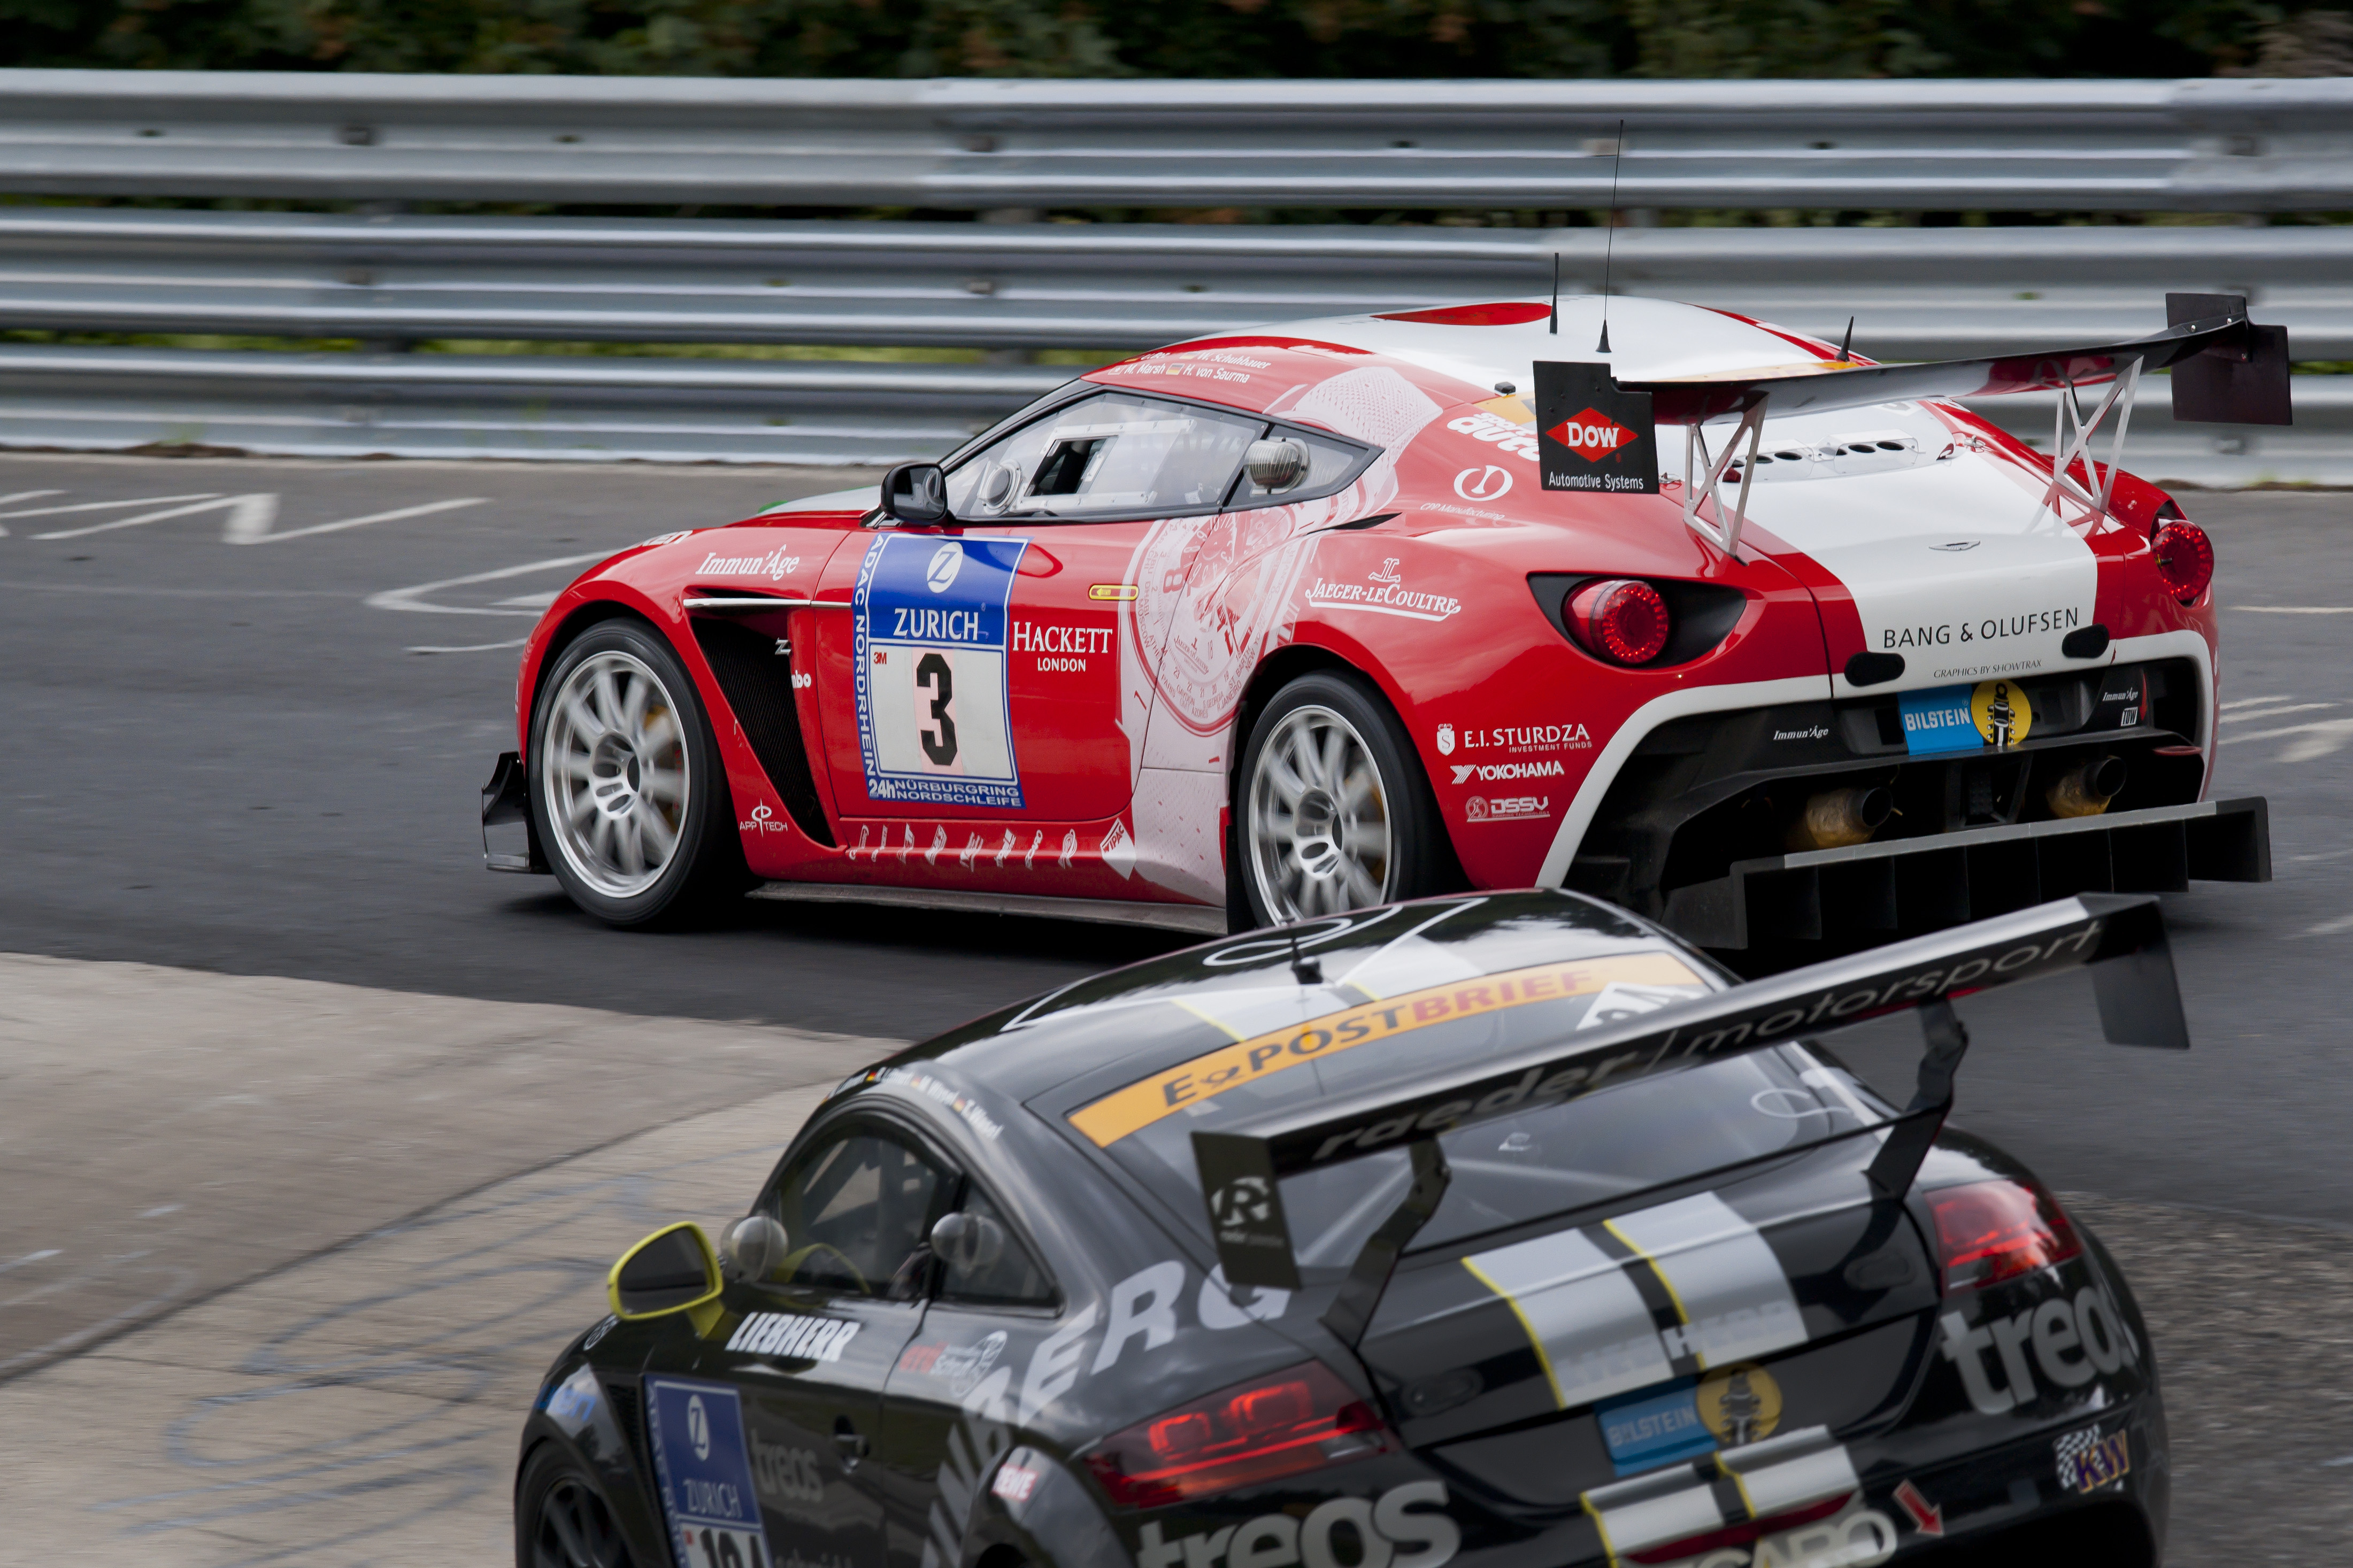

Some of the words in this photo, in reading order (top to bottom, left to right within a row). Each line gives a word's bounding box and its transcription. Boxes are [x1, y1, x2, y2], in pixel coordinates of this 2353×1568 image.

[1124, 364, 1133, 374] M.
[1136, 363, 1165, 374] Marsh
[1211, 353, 1271, 369] Schuhbauer
[1183, 365, 1192, 375] H.
[1196, 368, 1213, 378] von
[1213, 367, 1250, 383] Saurma
[1567, 422, 1620, 448] DOW
[1549, 472, 1601, 488] Automotive
[1605, 474, 1644, 492] Systems
[855, 534, 883, 606] ADAC
[893, 608, 979, 641] ZURICH
[1884, 624, 1951, 648] BANG
[1960, 622, 1974, 642] &
[1981, 607, 2079, 639] OLUFSEN
[1013, 622, 1113, 653] HACKETT
[873, 652, 887, 666] 3M
[1037, 657, 1087, 673] LONDON
[1934, 667, 1978, 679] GRAPHICS
[1980, 665, 1991, 675] BY
[1992, 659, 2042, 674] SHOWTRAX
[856, 615, 876, 776] NORDRHEIN
[916, 653, 958, 766] 3
[1904, 707, 1971, 732] BILSTEIN
[2121, 707, 2137, 726] TOW
[1464, 730, 1490, 748] E.I.
[1493, 723, 1590, 746] STURDZA
[1509, 743, 1560, 753] INVESTMENT
[1564, 741, 1593, 751] FUNDS
[1476, 760, 1565, 781] YOKOHAMA
[868, 778, 896, 799] 24h
[895, 778, 1019, 797] NÜRBURGRING
[897, 791, 1022, 807] NORDSCHLEIFE
[740, 821, 757, 831] APP
[763, 821, 788, 832] TECH
[1249, 969, 1593, 1071] POSTBRIEF
[1312, 1051, 1638, 1161] raeder
[1681, 921, 2101, 1065] motorsport
[725, 1311, 860, 1363] LIEBHERR
[1608, 1403, 1699, 1448] BILSTEIN
[2075, 1430, 2130, 1494] KW
